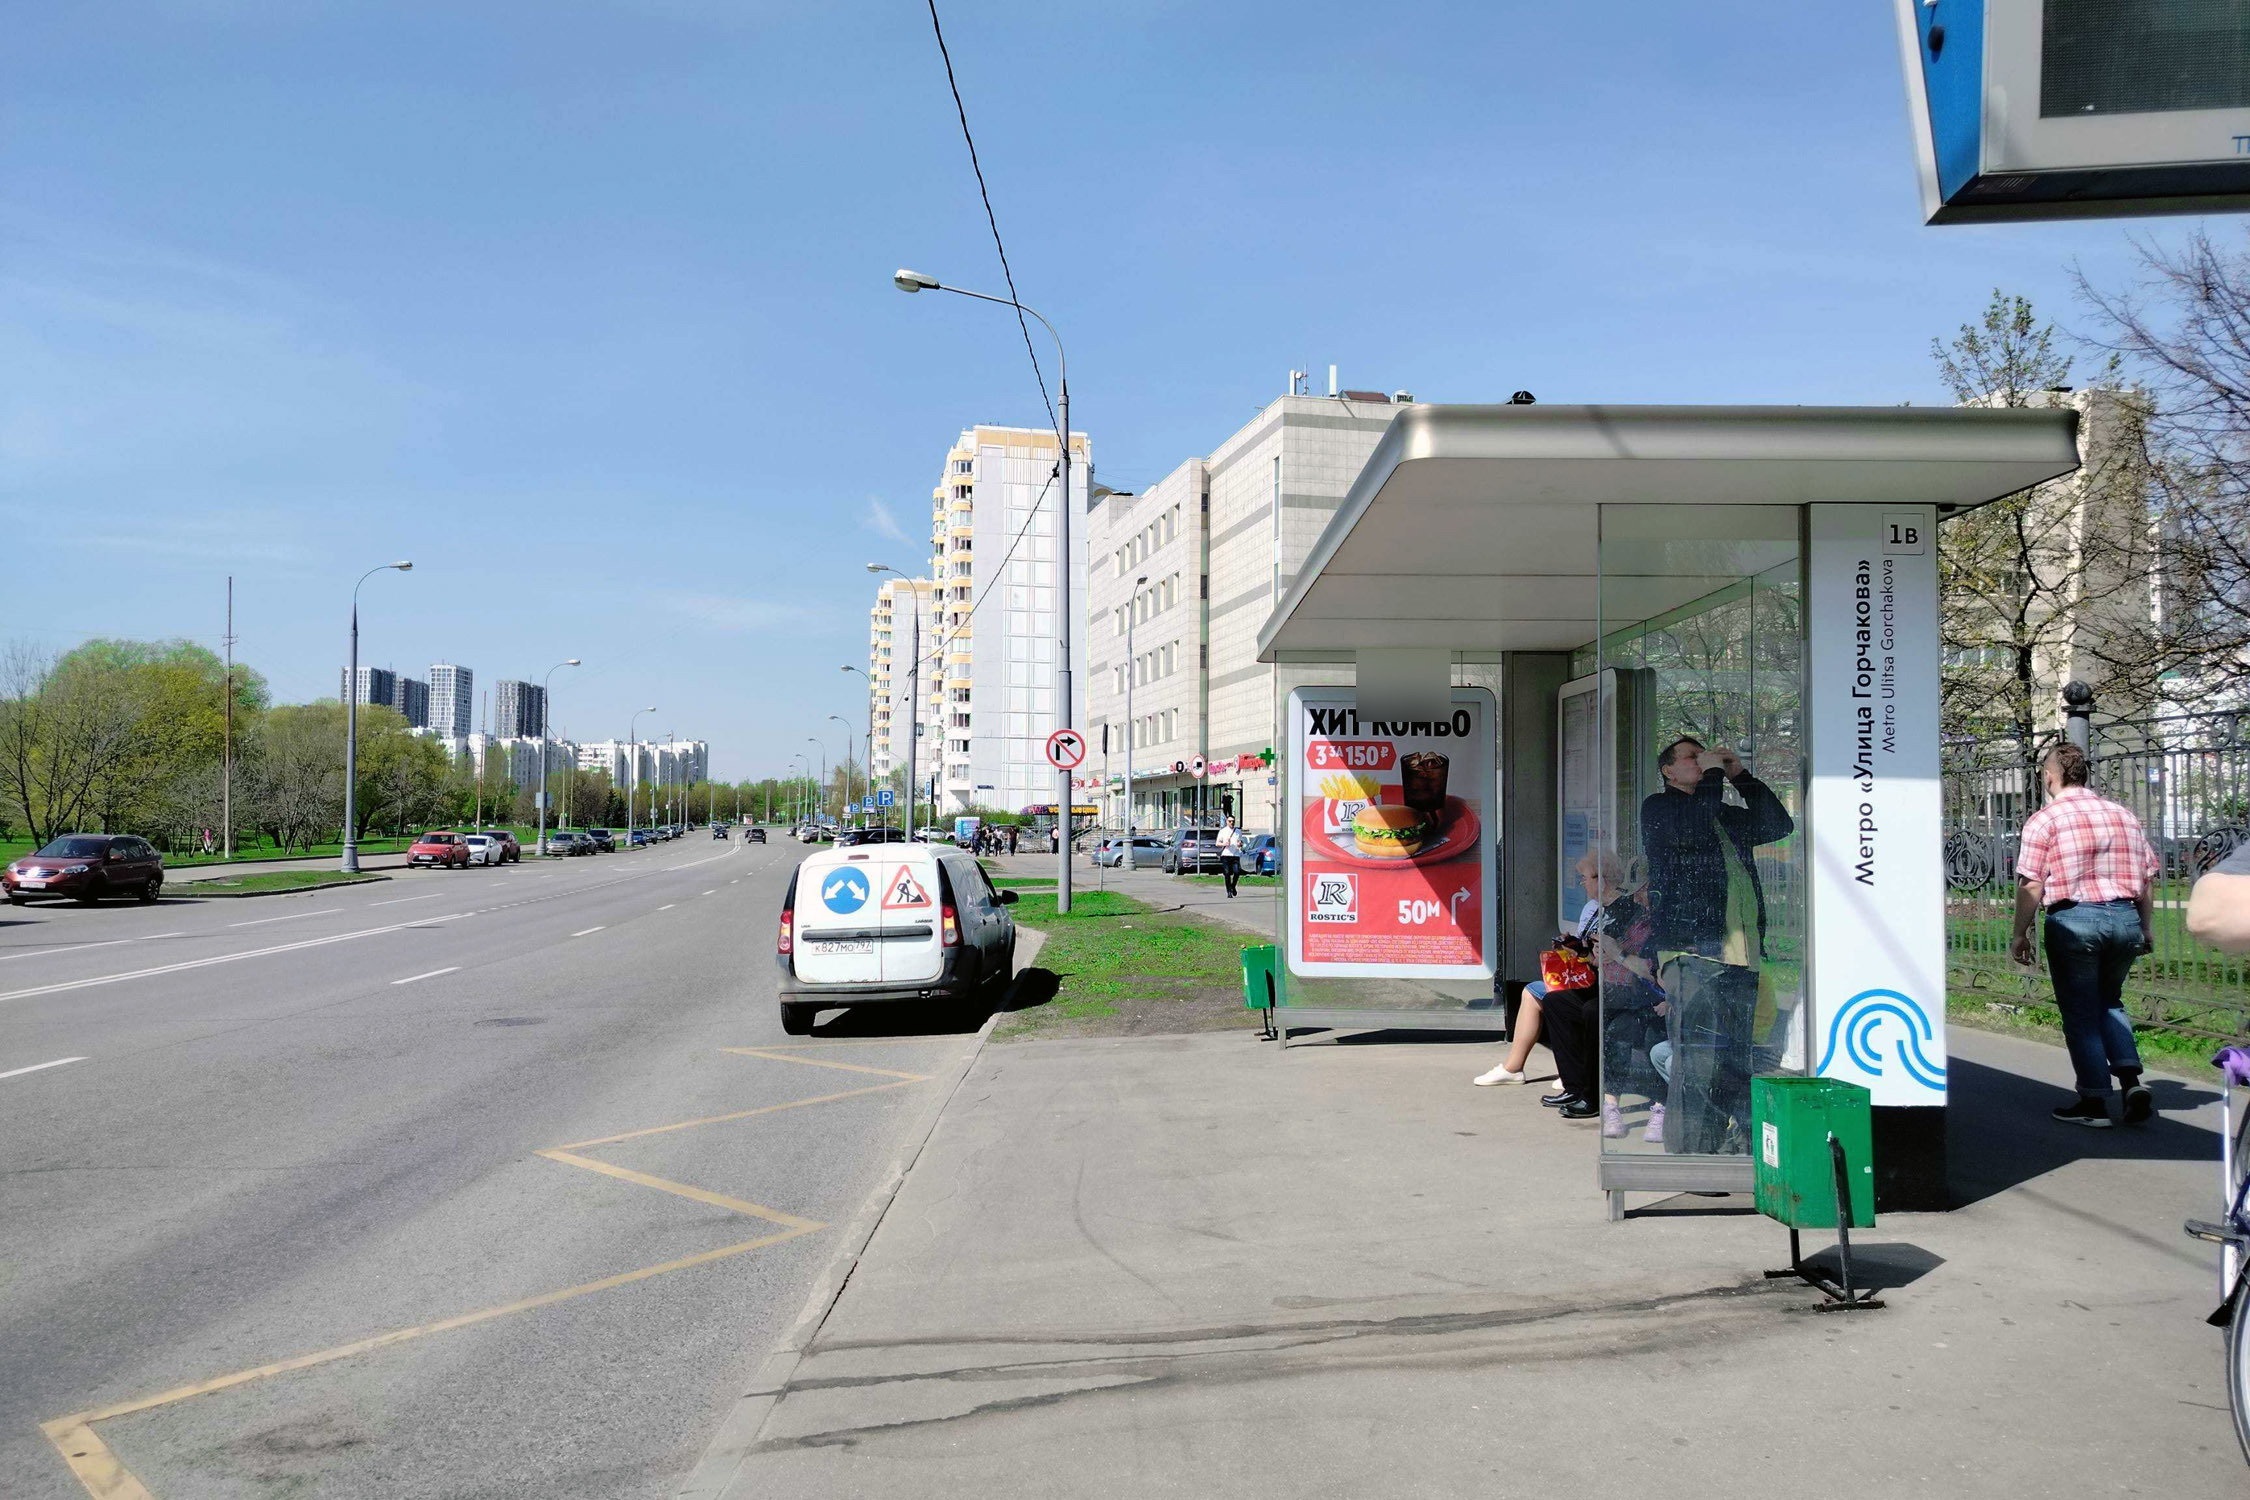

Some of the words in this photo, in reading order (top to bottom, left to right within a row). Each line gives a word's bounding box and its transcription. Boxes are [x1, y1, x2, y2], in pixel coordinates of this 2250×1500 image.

[1852, 559, 1877, 698] Горчакова»
[1880, 559, 1895, 651] Gorchakova
[1881, 655, 1895, 699] Ulitsa
[1309, 709, 1360, 736] ХИТ
[1853, 706, 1876, 793] «Улица
[1882, 704, 1896, 753] Metro
[1855, 802, 1879, 886] Метро
[1311, 913, 1356, 921] ROSTIC'S
